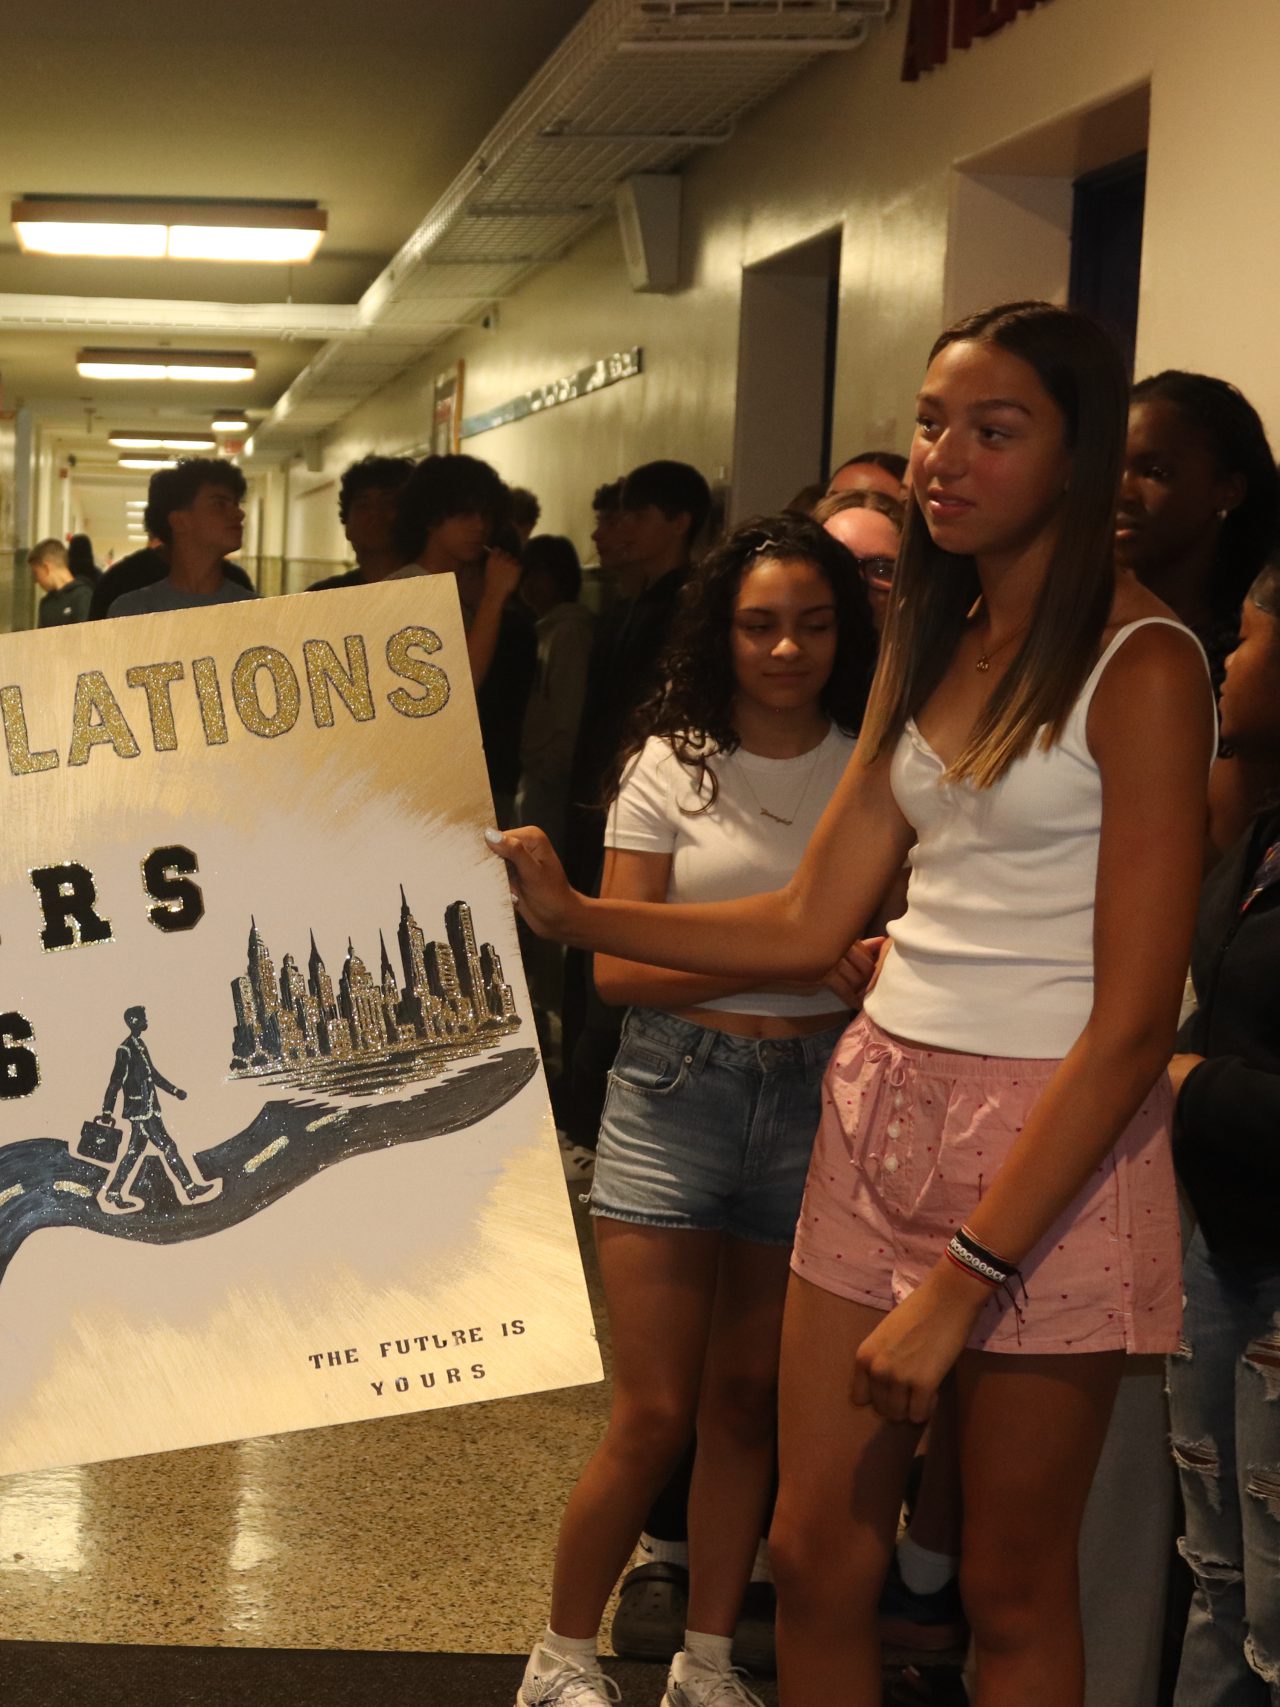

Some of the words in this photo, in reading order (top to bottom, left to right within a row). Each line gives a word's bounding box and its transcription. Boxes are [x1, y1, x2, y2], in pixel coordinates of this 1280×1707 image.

[308, 1348, 359, 1369] THE
[501, 1319, 526, 1337] IS
[370, 1363, 486, 1396] YOURS
